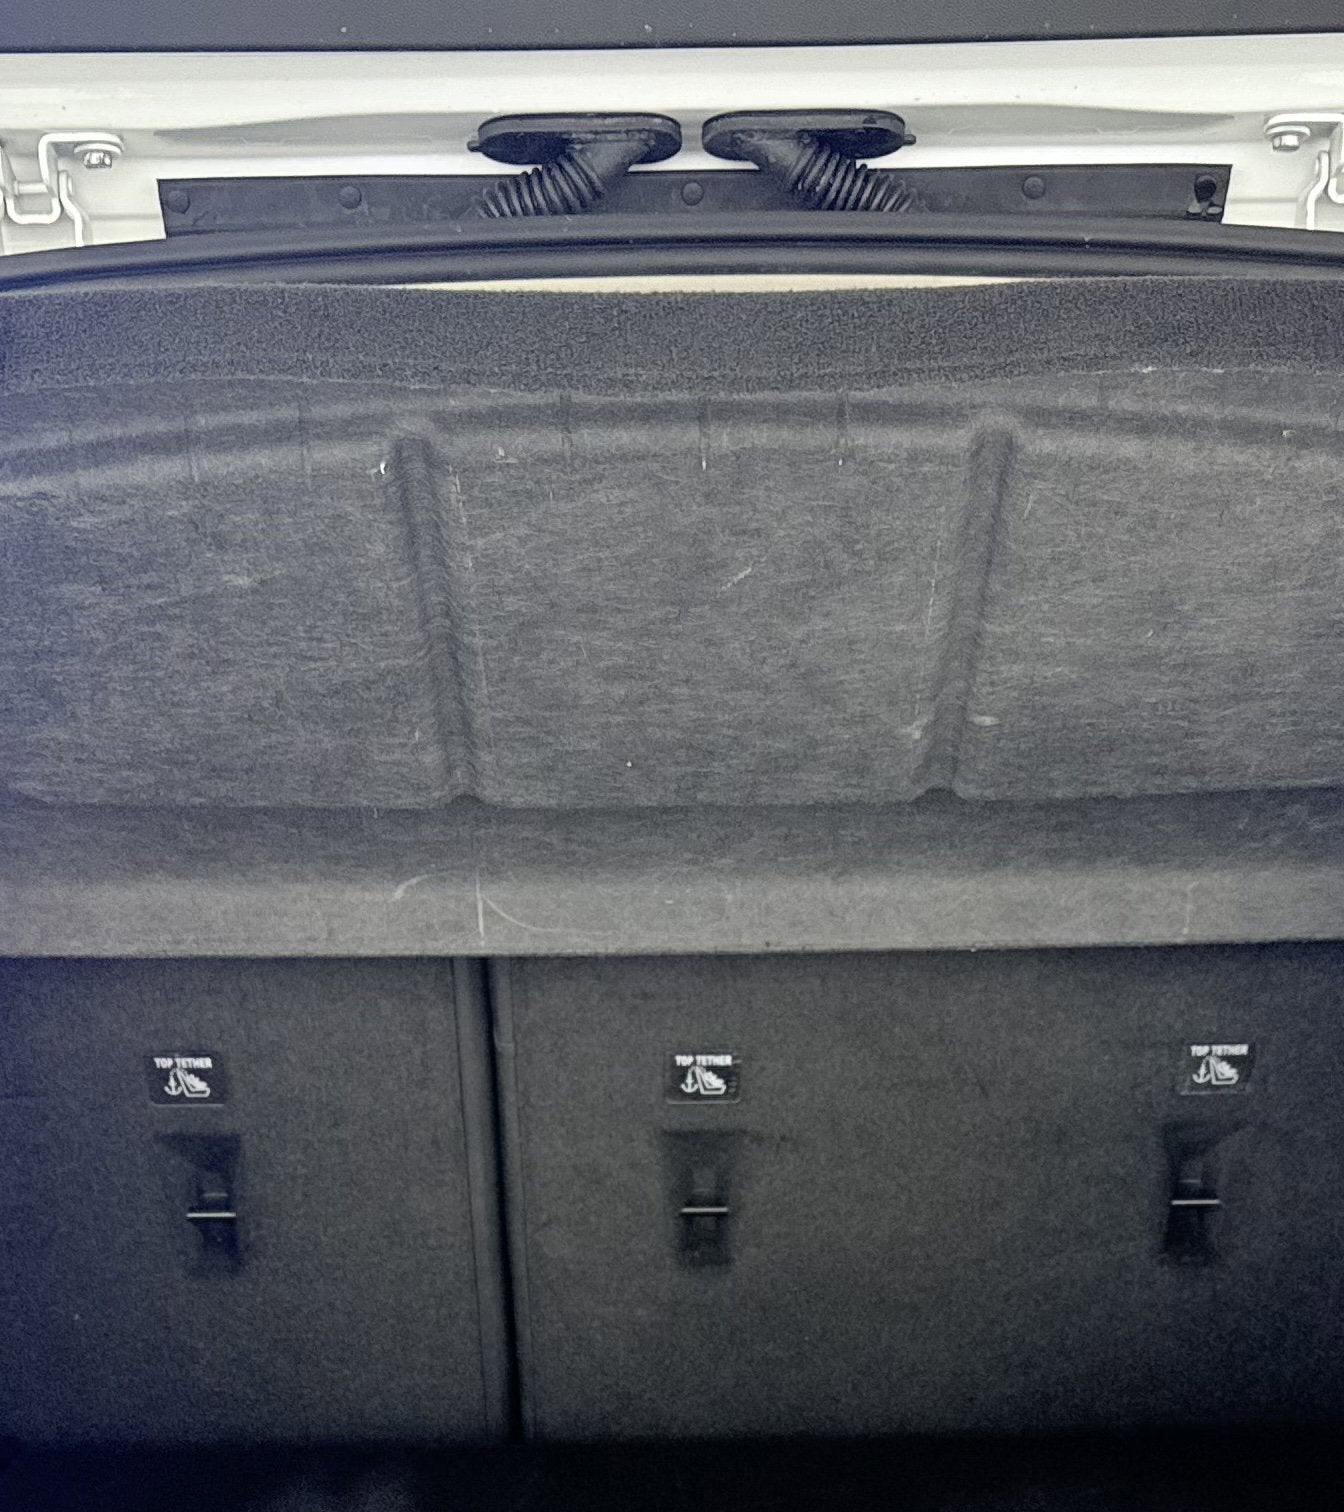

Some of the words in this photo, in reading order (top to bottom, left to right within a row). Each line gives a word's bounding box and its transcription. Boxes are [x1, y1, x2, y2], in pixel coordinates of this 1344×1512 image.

[1190, 1044, 1210, 1057] TOP
[153, 1057, 174, 1069] TOP
[175, 1057, 213, 1069] TETHER
[674, 1054, 695, 1066] TOP
[695, 1054, 733, 1066] TETHER
